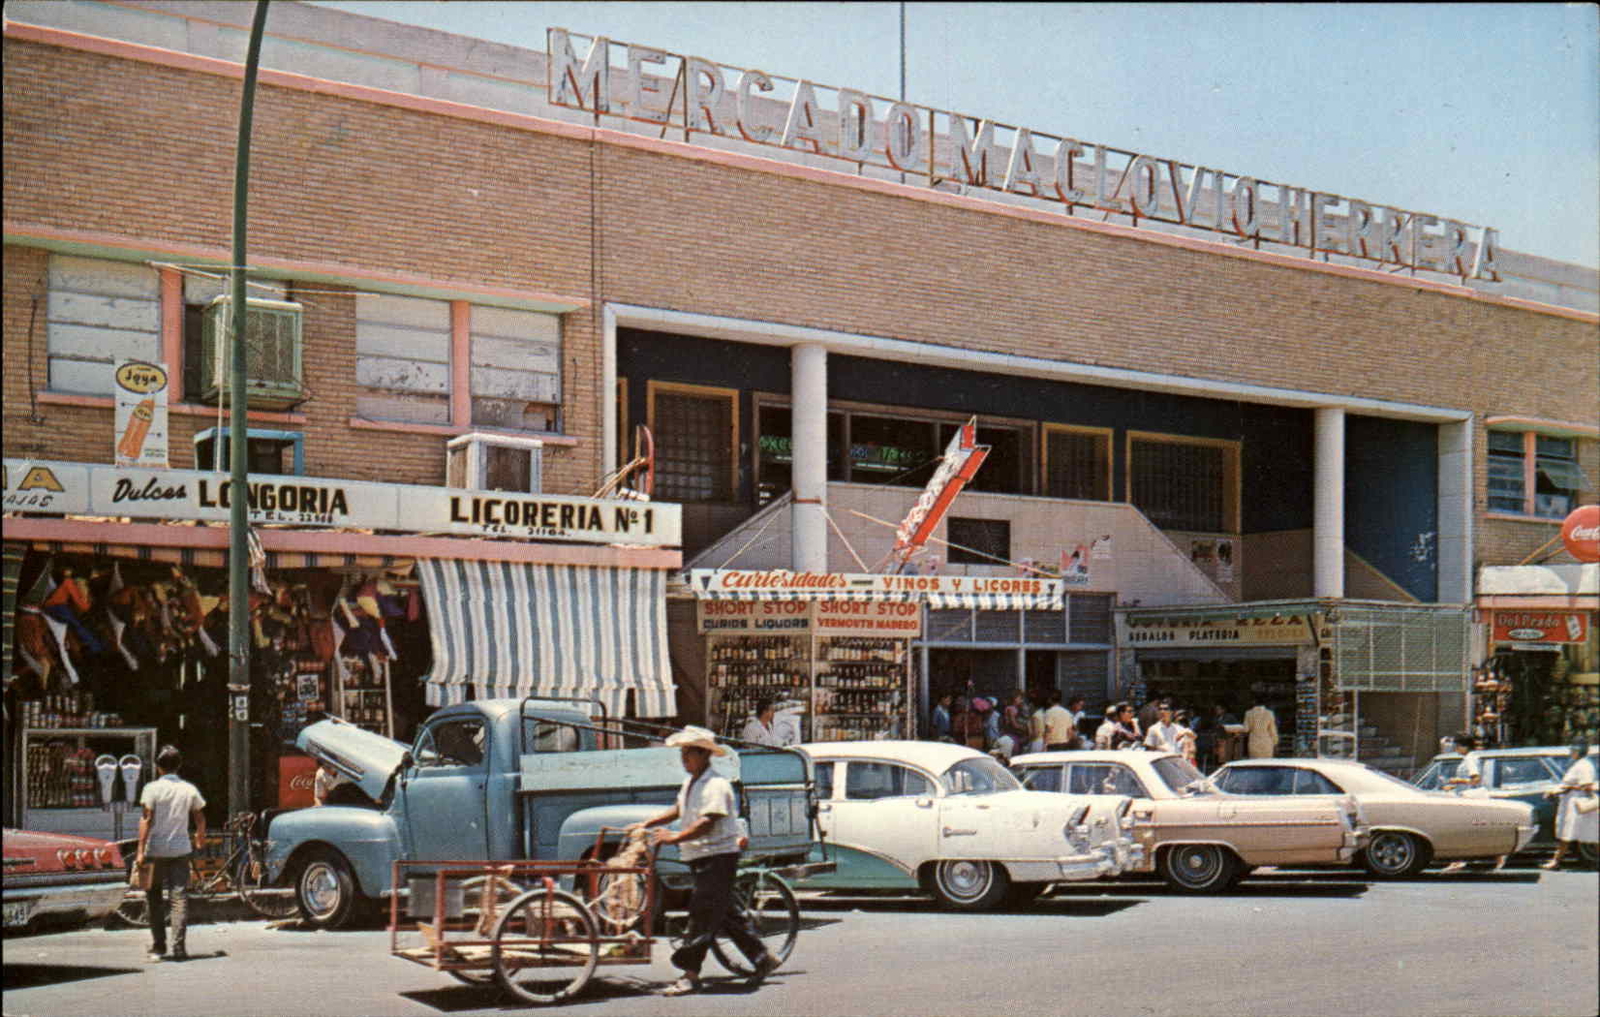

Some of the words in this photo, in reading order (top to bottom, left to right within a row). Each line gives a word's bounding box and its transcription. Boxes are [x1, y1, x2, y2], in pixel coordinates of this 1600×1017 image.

[549, 27, 921, 171] MERCADO
[949, 113, 1259, 239] MACLOVIO
[1279, 185, 1502, 281] HERRERA
[113, 477, 187, 503] Dulces
[198, 479, 348, 515] LONGORIA
[250, 511, 293, 521] TEL.
[451, 496, 603, 531] LICORERIA
[644, 508, 653, 533] 1
[483, 524, 511, 534] TEL.
[722, 571, 847, 588] Curiosidades
[883, 577, 940, 590] VINOS
[952, 579, 962, 590] Y
[974, 579, 1041, 593] LICORES
[704, 601, 756, 615] SHORT
[763, 601, 807, 614] STOP
[820, 601, 871, 614] SHORT
[878, 602, 916, 615] STOP
[703, 619, 747, 629] CURIOS
[755, 619, 808, 629] LIQUORS
[817, 618, 873, 629] VERMOUTH
[1189, 629, 1239, 641] PLATERIA
